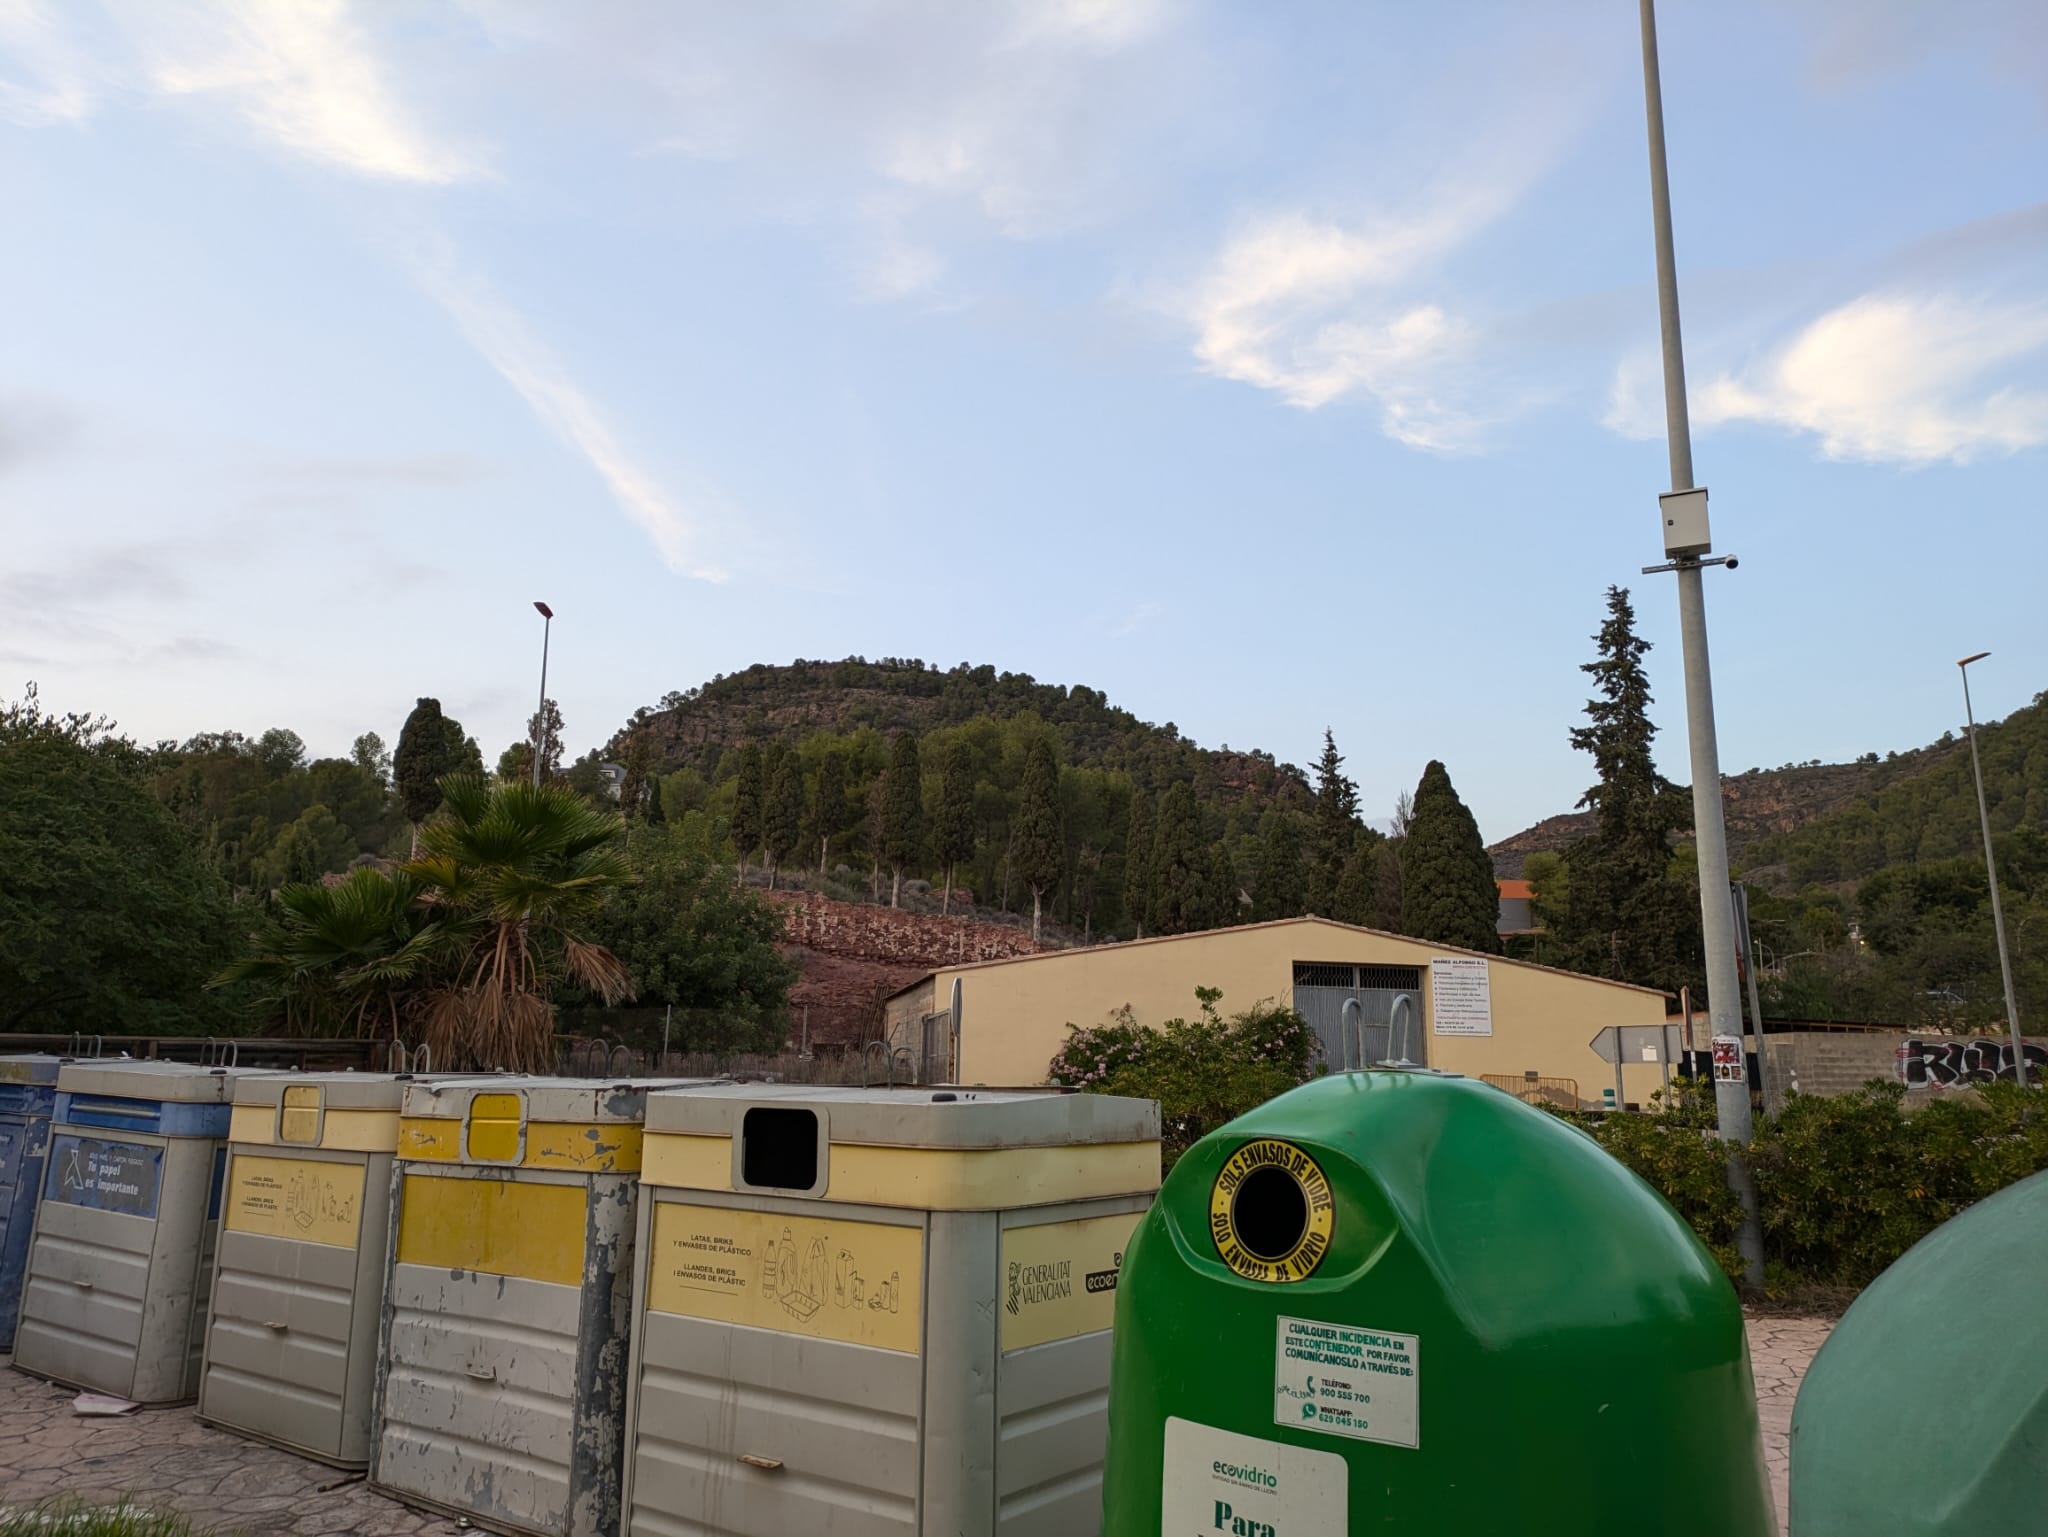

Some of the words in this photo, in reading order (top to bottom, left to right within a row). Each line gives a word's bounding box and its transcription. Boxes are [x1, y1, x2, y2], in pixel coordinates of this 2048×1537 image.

[87, 1160, 97, 1173] Tu
[99, 1164, 121, 1177] papel
[1219, 1158, 1245, 1196] SOLS
[1240, 1142, 1292, 1170] ENVASOS
[1290, 1153, 1310, 1178] DE
[1302, 1168, 1331, 1213] VIDRE
[84, 1178, 95, 1188] es
[97, 1178, 139, 1196] importante
[678, 1240, 707, 1251] ENVASES
[708, 1244, 717, 1252] DE
[718, 1245, 752, 1256] PLÁSTICO
[690, 1234, 711, 1243] LATAS,
[713, 1237, 734, 1246] BRIKS
[1213, 1212, 1231, 1243] SOLO
[1224, 1244, 1269, 1280] ENVASES
[1275, 1263, 1290, 1281] DE
[1290, 1231, 1326, 1276] VIDRIO
[676, 1270, 707, 1280] ENVASOS
[708, 1274, 717, 1282] DE
[683, 1263, 715, 1274] LLANDES,
[716, 1267, 736, 1277] BRICS
[1022, 1260, 1071, 1286] GENERALITAT
[1022, 1280, 1072, 1304] VALENCIANA
[1289, 1323, 1338, 1340] CUALQUIER
[1339, 1331, 1392, 1348] INCIDENCIA
[1393, 1341, 1404, 1351] EN
[1285, 1336, 1303, 1347] ESTE
[1304, 1338, 1364, 1357] CONTENEDOR,
[1366, 1349, 1382, 1360] POR
[1384, 1352, 1410, 1364] FAVOR
[1285, 1347, 1359, 1369] COMUNÍCANOSLO
[1360, 1361, 1367, 1370] A
[1367, 1362, 1399, 1375] TRAVÉS
[1400, 1367, 1414, 1376] DE:
[1320, 1388, 1336, 1398] 900
[1337, 1390, 1353, 1401] 555
[1354, 1393, 1370, 1404] 700
[1319, 1413, 1334, 1424] 629
[1335, 1416, 1351, 1427] 045
[1354, 1419, 1368, 1430] 150
[1320, 1406, 1353, 1417] WHATSAPP:
[1213, 1460, 1277, 1488] ecovidrio
[1214, 1500, 1276, 1537] Para
